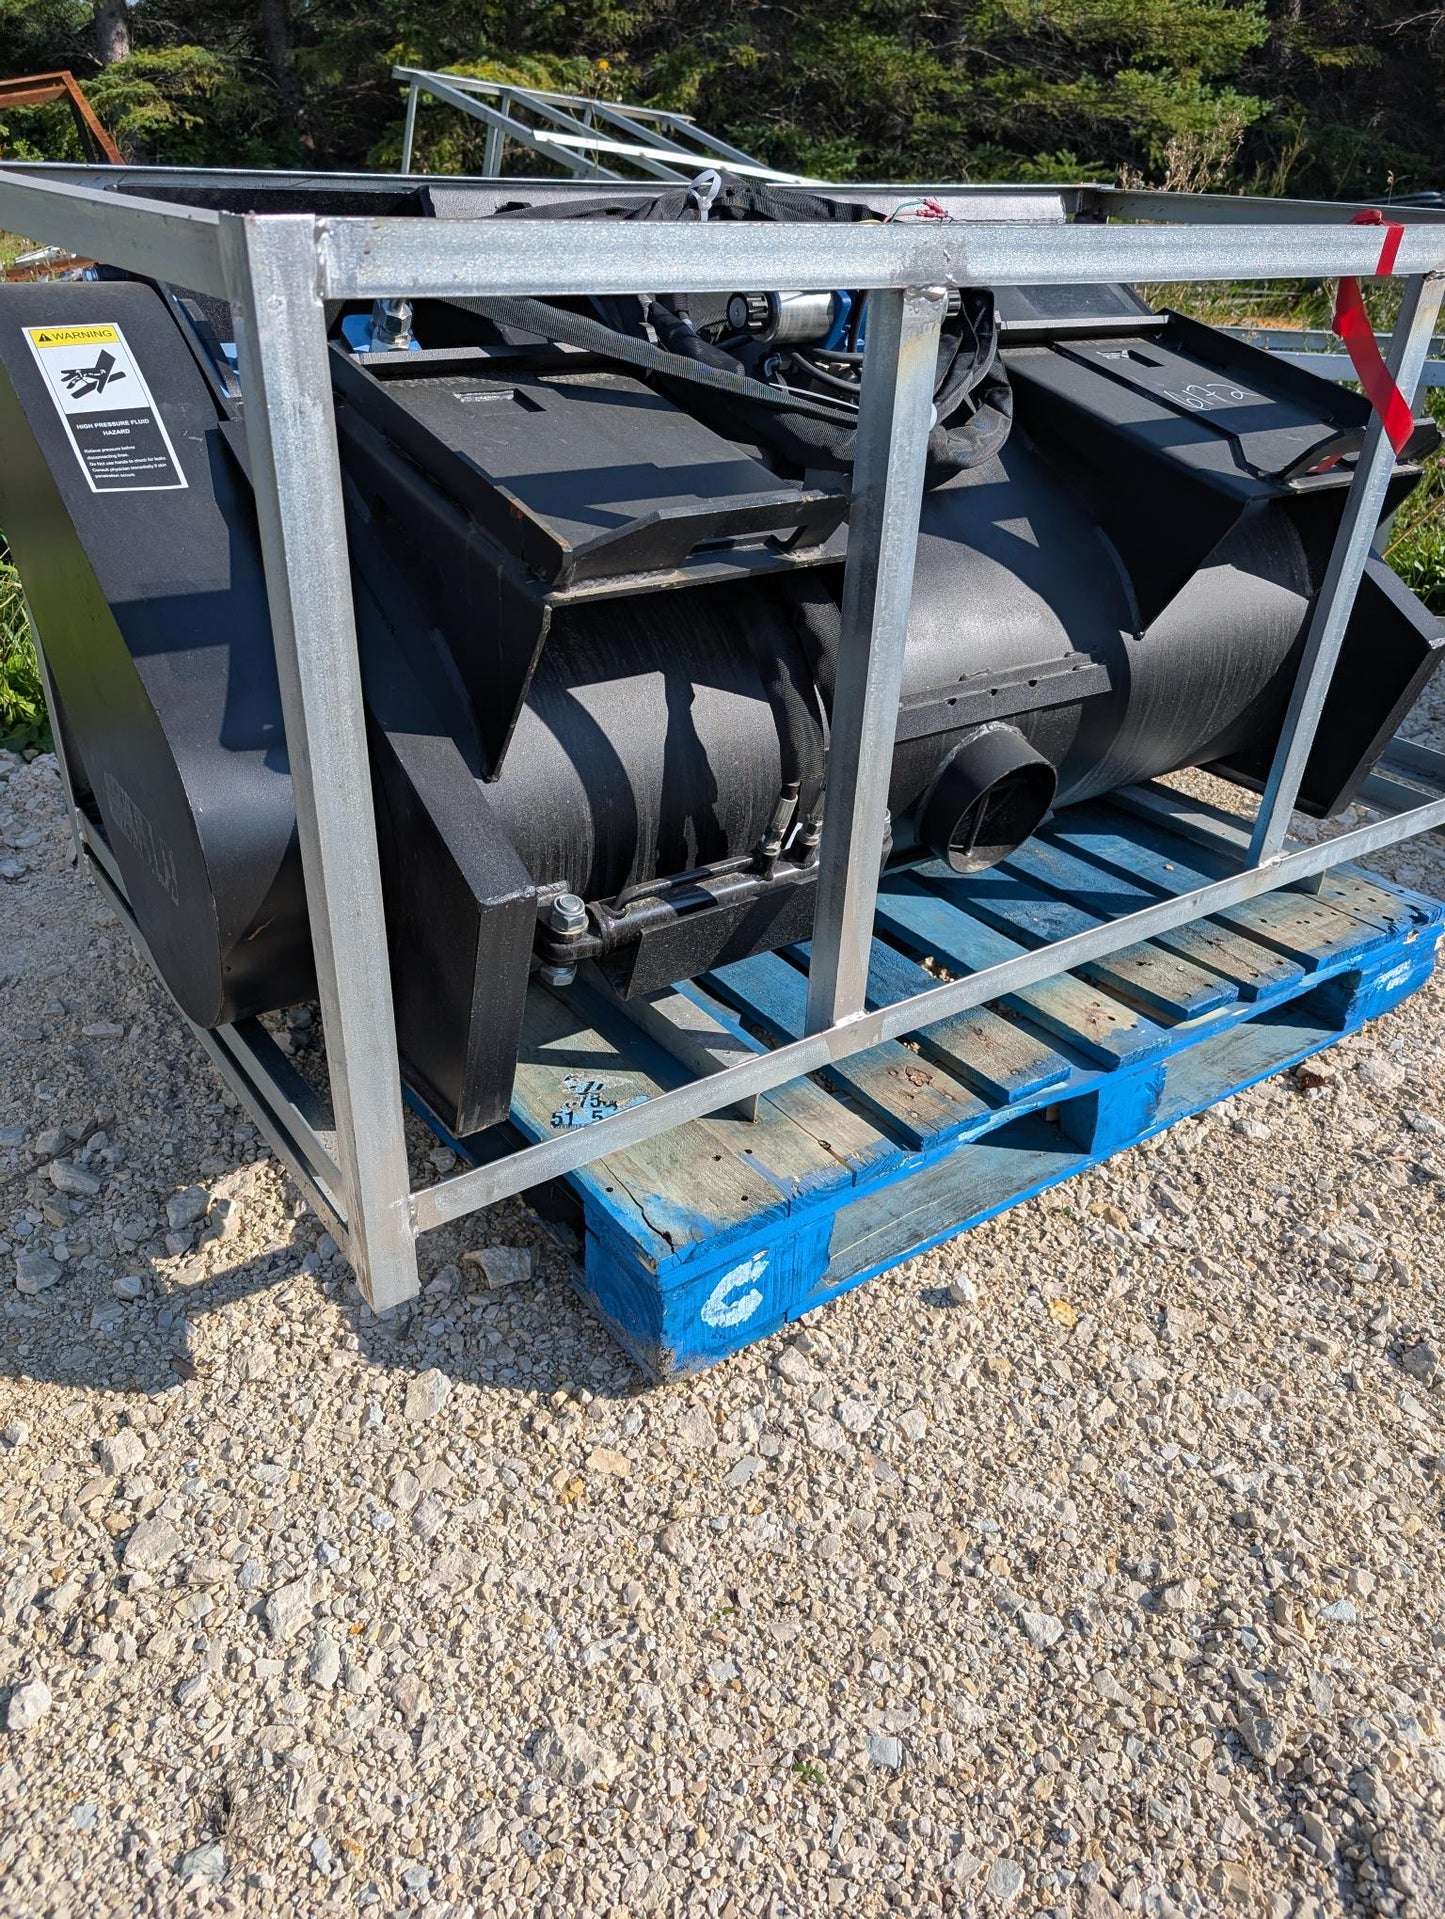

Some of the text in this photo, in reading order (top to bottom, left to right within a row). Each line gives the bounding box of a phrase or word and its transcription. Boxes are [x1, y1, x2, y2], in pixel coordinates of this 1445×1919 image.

[52, 329, 112, 340] WARNING
[94, 420, 130, 429] PRESSURE
[102, 428, 130, 436] HAZARD
